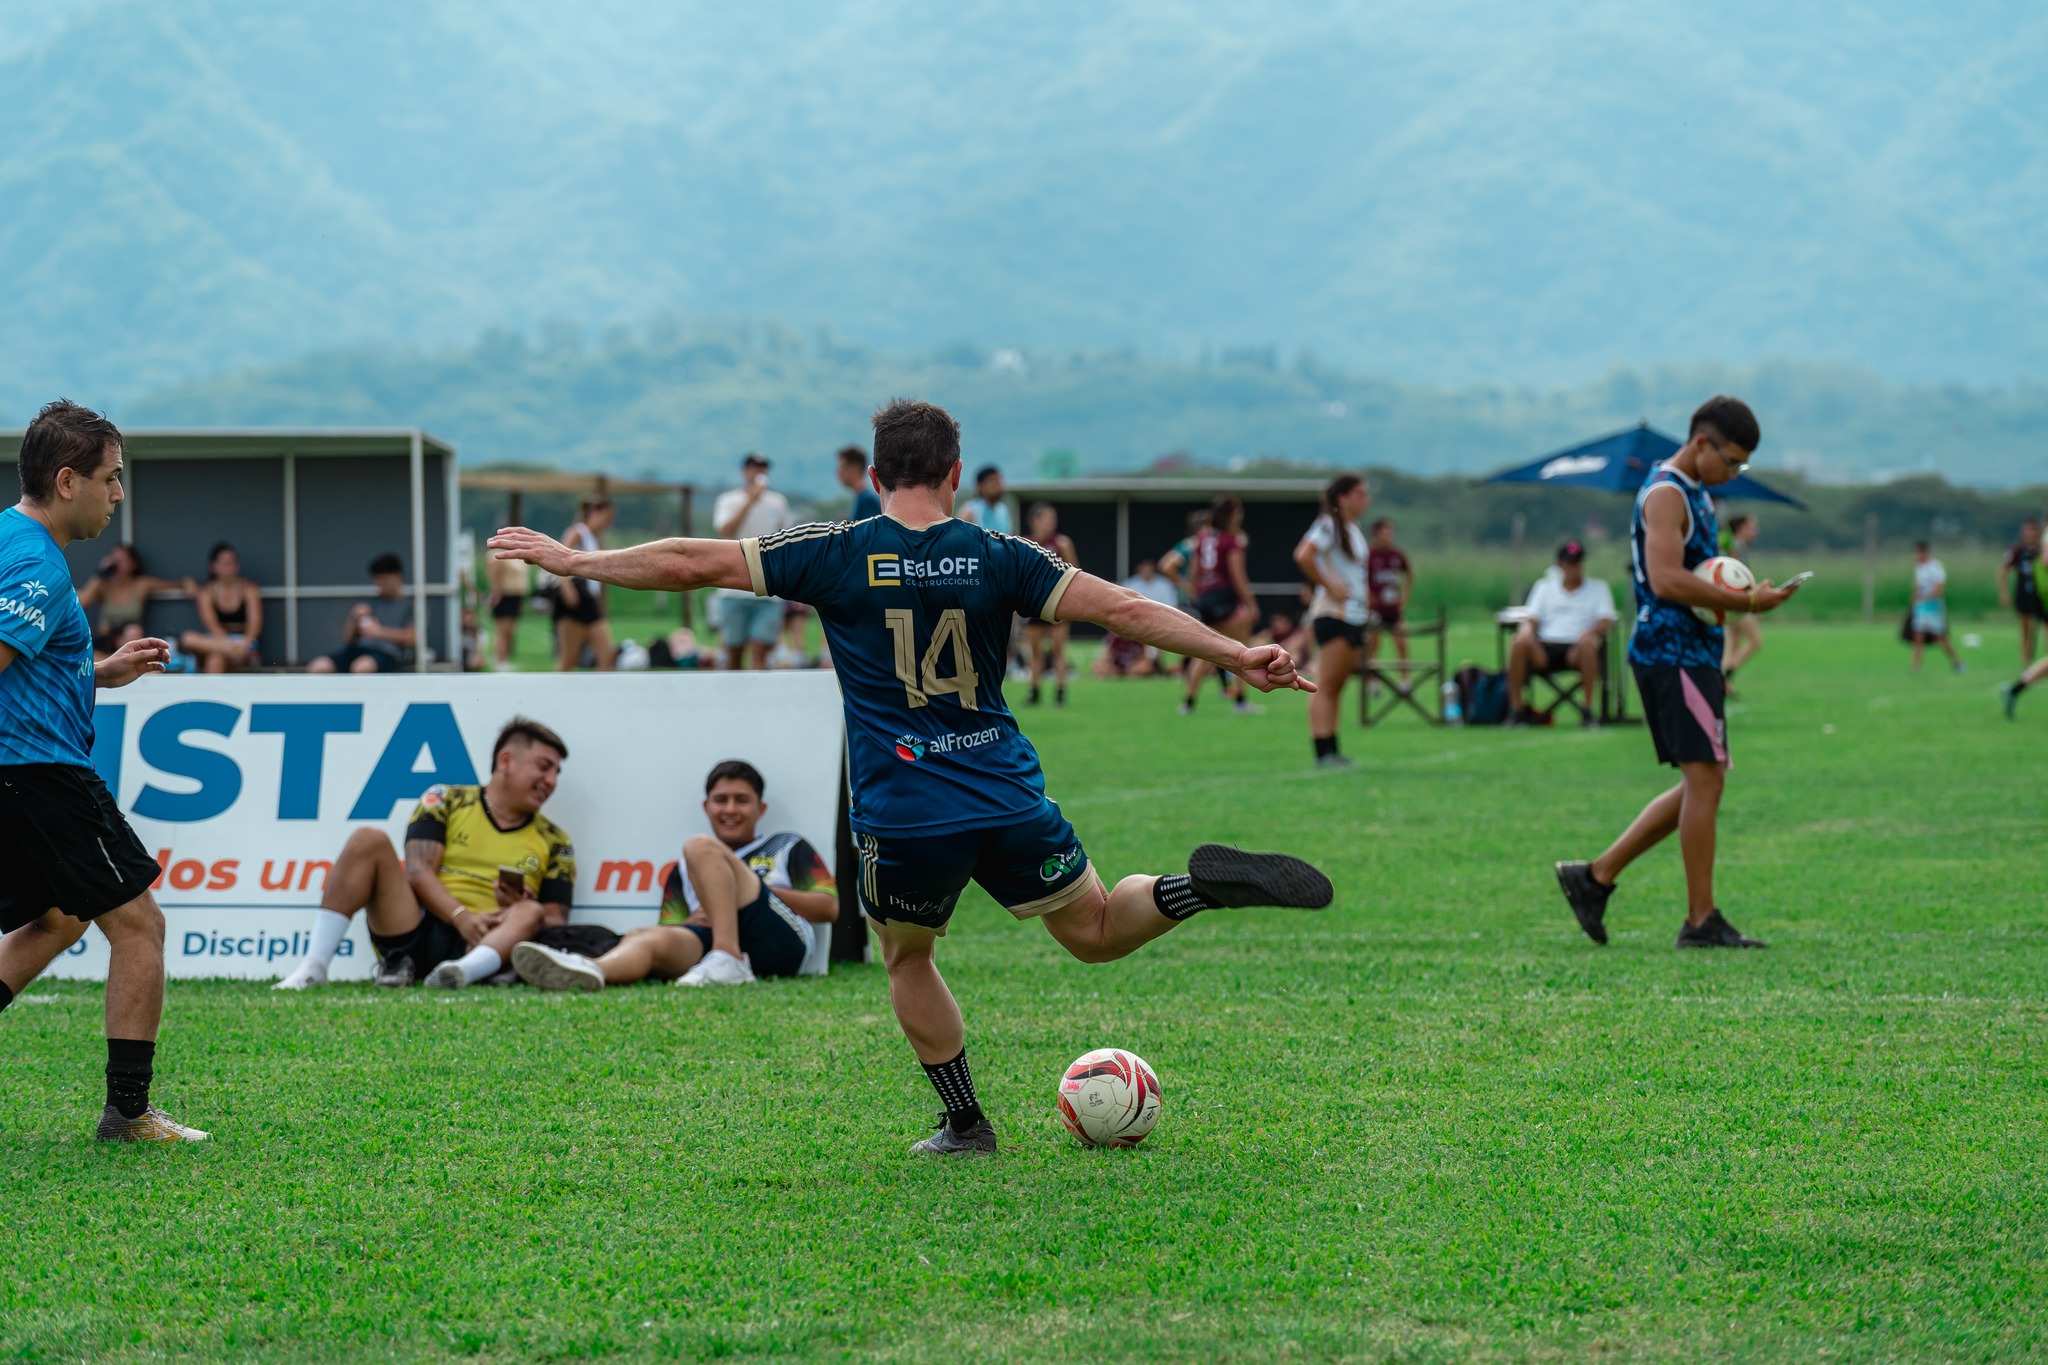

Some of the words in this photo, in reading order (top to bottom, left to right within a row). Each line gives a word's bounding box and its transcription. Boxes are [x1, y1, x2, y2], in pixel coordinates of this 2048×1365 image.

[903, 557, 979, 578] EGLOFF
[905, 578, 980, 588] COTRUCCIONES
[885, 609, 979, 711] 14
[929, 727, 1000, 753] allFrozen
[182, 930, 355, 963] Disciplia
